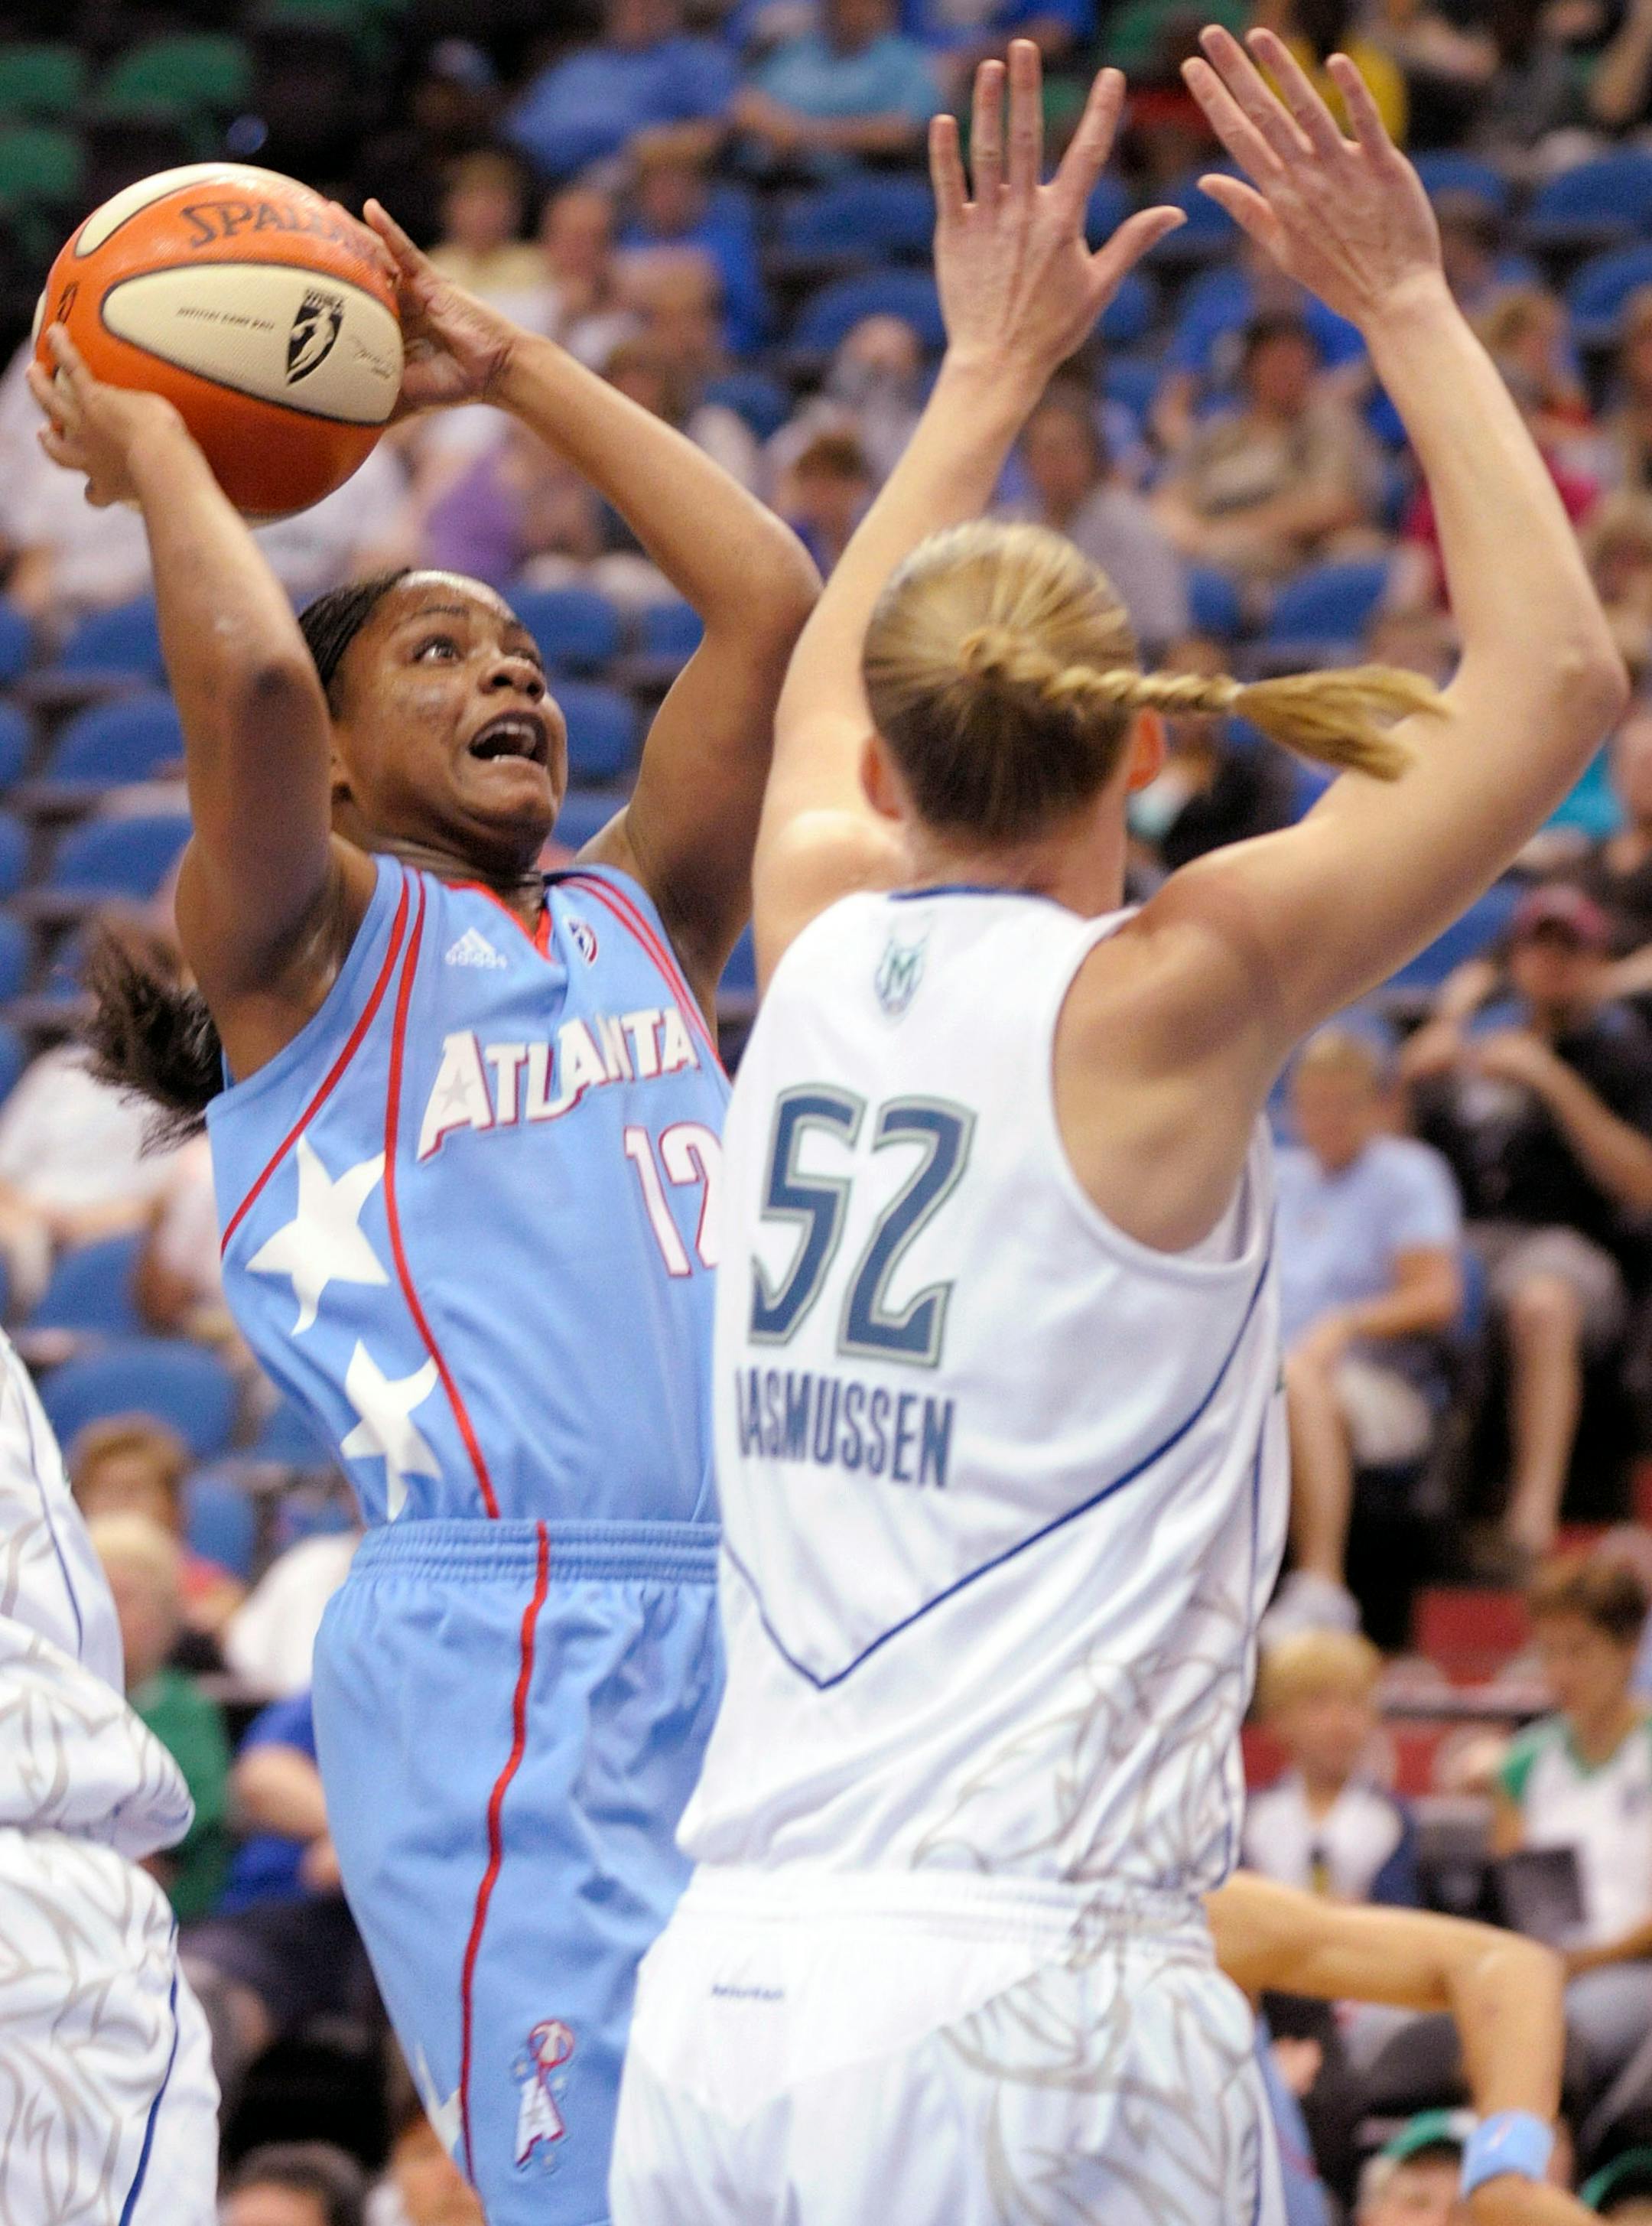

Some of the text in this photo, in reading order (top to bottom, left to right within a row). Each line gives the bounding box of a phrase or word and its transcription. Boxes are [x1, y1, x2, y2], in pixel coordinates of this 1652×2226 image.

[417, 1006, 702, 1163] ATLANTA
[748, 1082, 978, 1370] 52
[733, 1365, 956, 1490] ASMUSSEN
